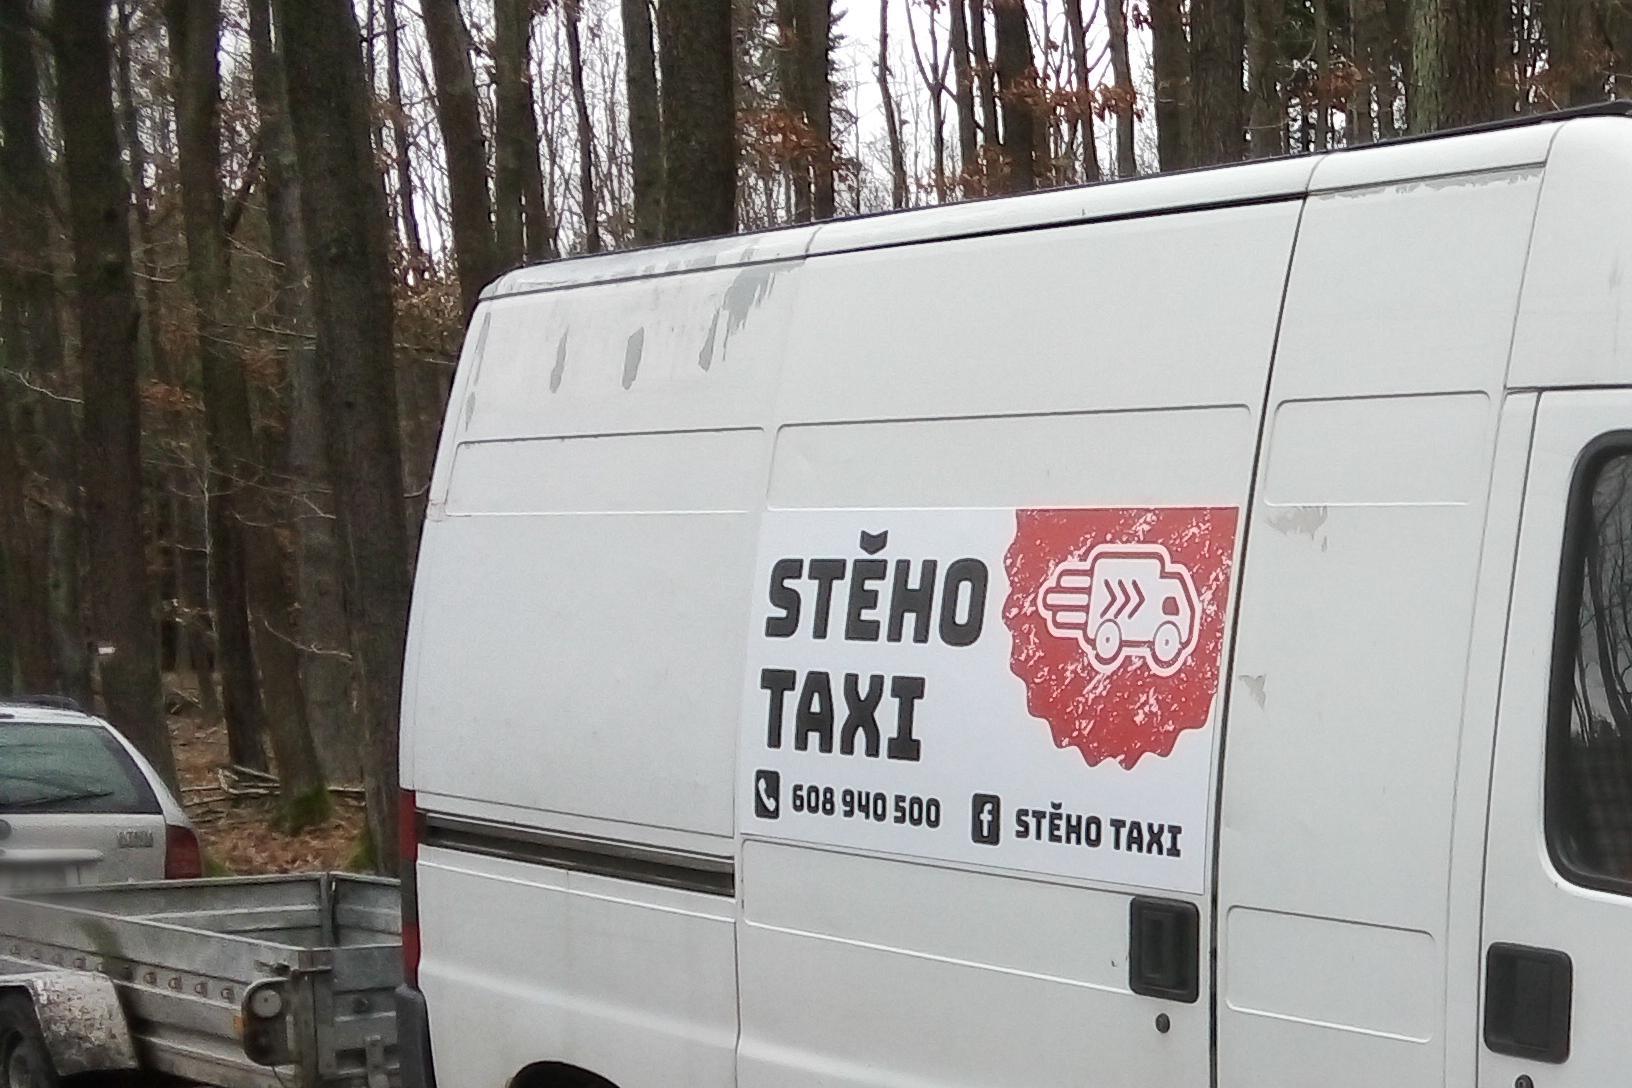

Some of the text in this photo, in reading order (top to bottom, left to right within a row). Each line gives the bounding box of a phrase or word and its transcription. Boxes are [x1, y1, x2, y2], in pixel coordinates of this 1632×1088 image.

[764, 529, 989, 648] STĚHO
[760, 668, 926, 762] TAXI
[791, 783, 941, 829] 608 940 500
[1015, 801, 1102, 848] STĚHO
[1109, 818, 1183, 858] TAXI
